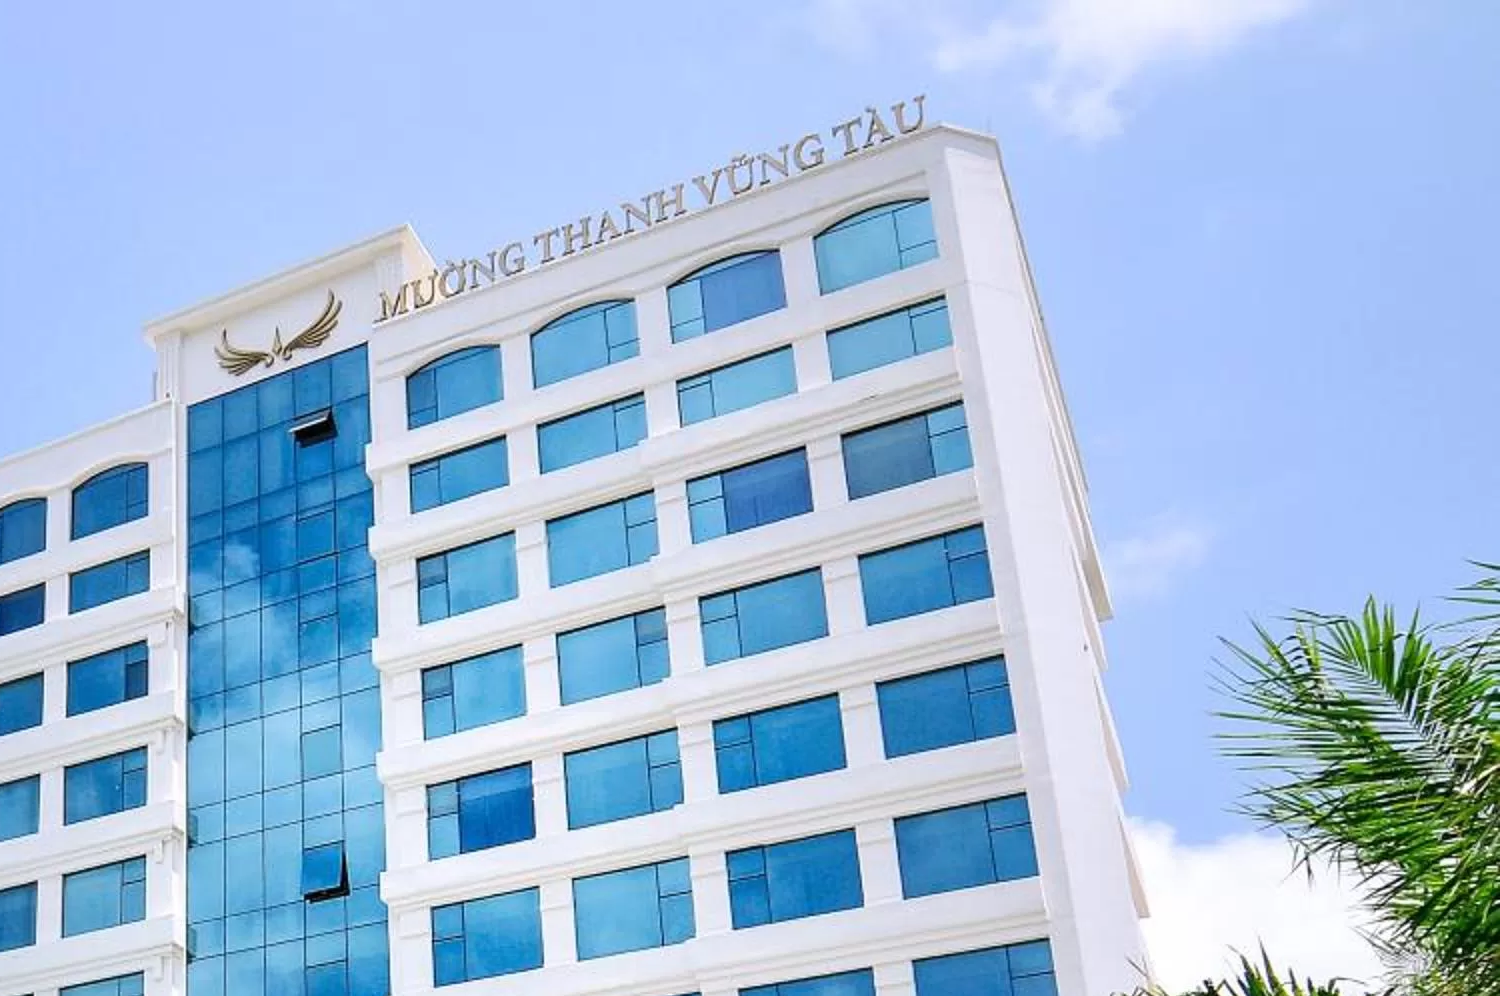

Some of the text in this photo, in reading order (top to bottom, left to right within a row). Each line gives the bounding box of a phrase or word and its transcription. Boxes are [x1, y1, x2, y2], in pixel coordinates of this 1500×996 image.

[373, 95, 927, 323] MƯỜNG THANH VŨNG TÀU
